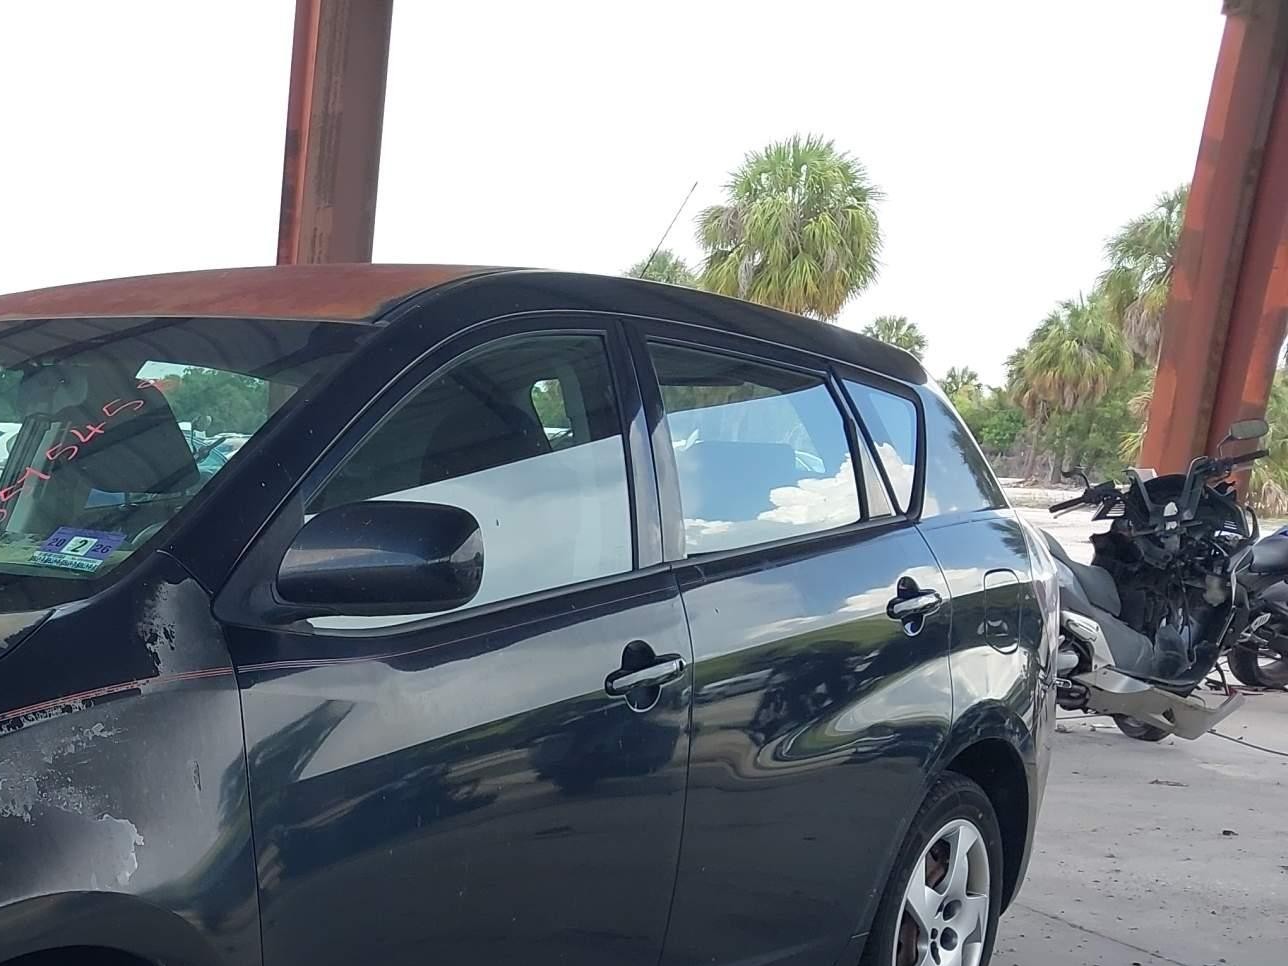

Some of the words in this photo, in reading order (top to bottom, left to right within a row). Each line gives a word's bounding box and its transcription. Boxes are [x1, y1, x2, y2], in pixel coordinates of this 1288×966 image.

[48, 538, 66, 547] 20
[70, 539, 89, 553] 2
[91, 543, 113, 554] 26
